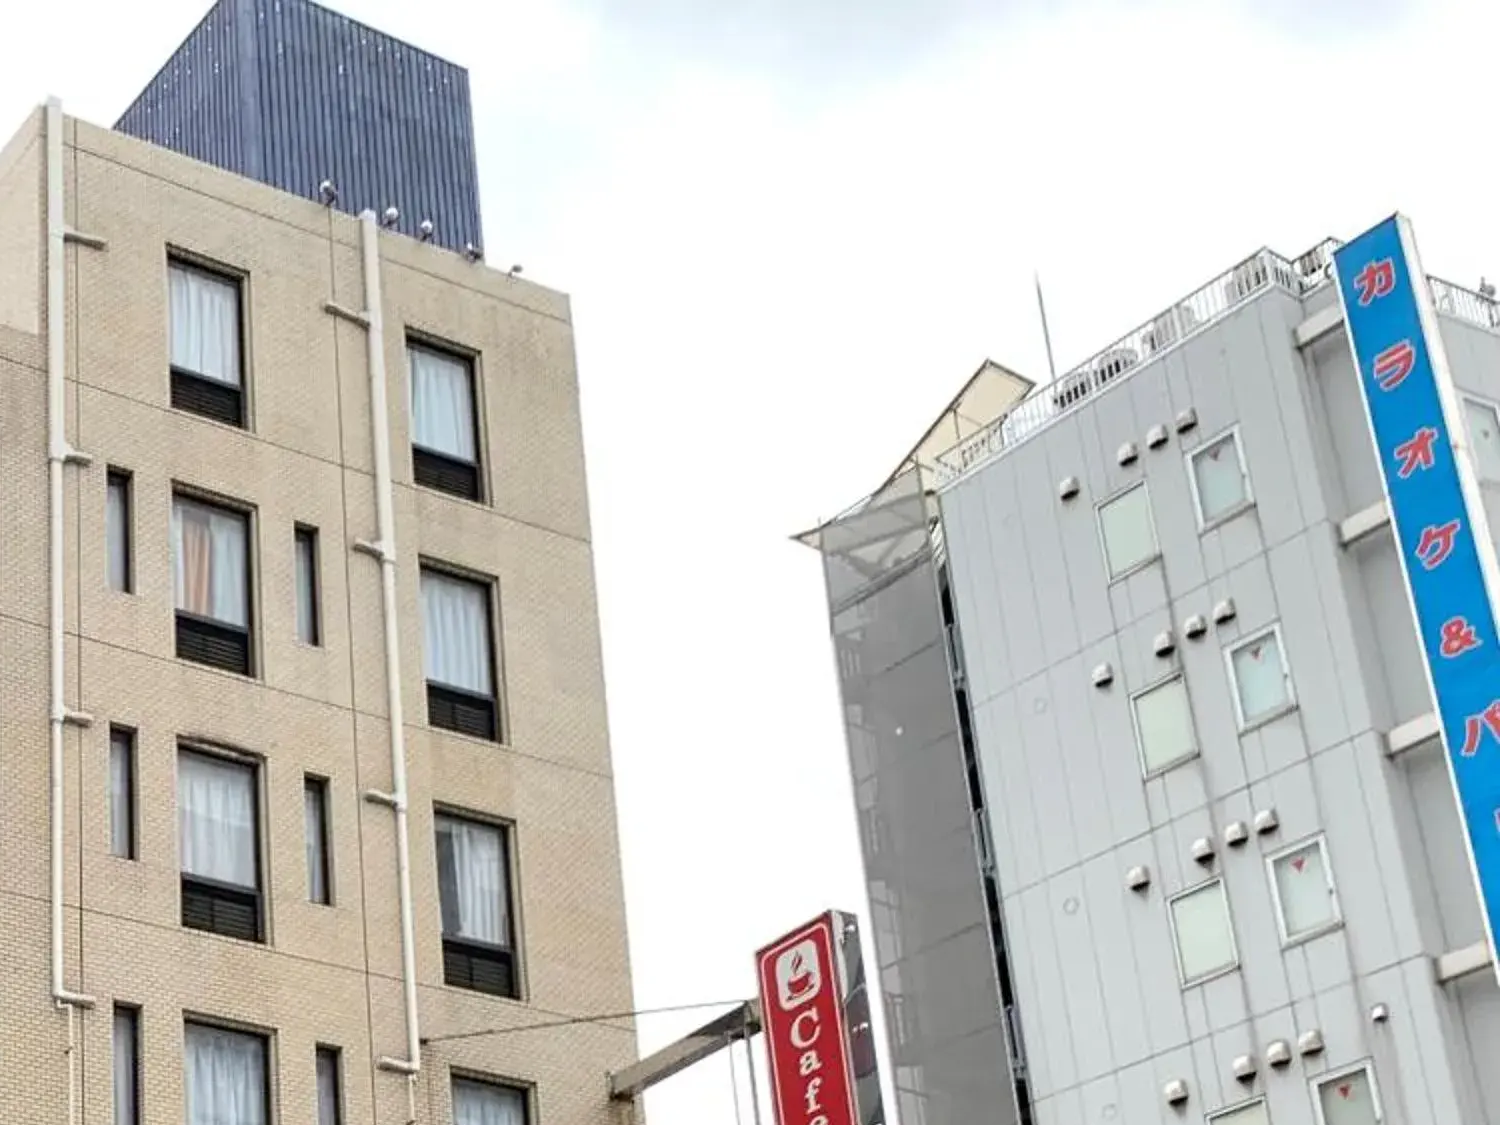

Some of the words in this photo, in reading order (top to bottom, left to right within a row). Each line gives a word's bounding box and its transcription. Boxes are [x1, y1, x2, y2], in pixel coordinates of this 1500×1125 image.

[1354, 256, 1500, 836] カラオケ&パ
